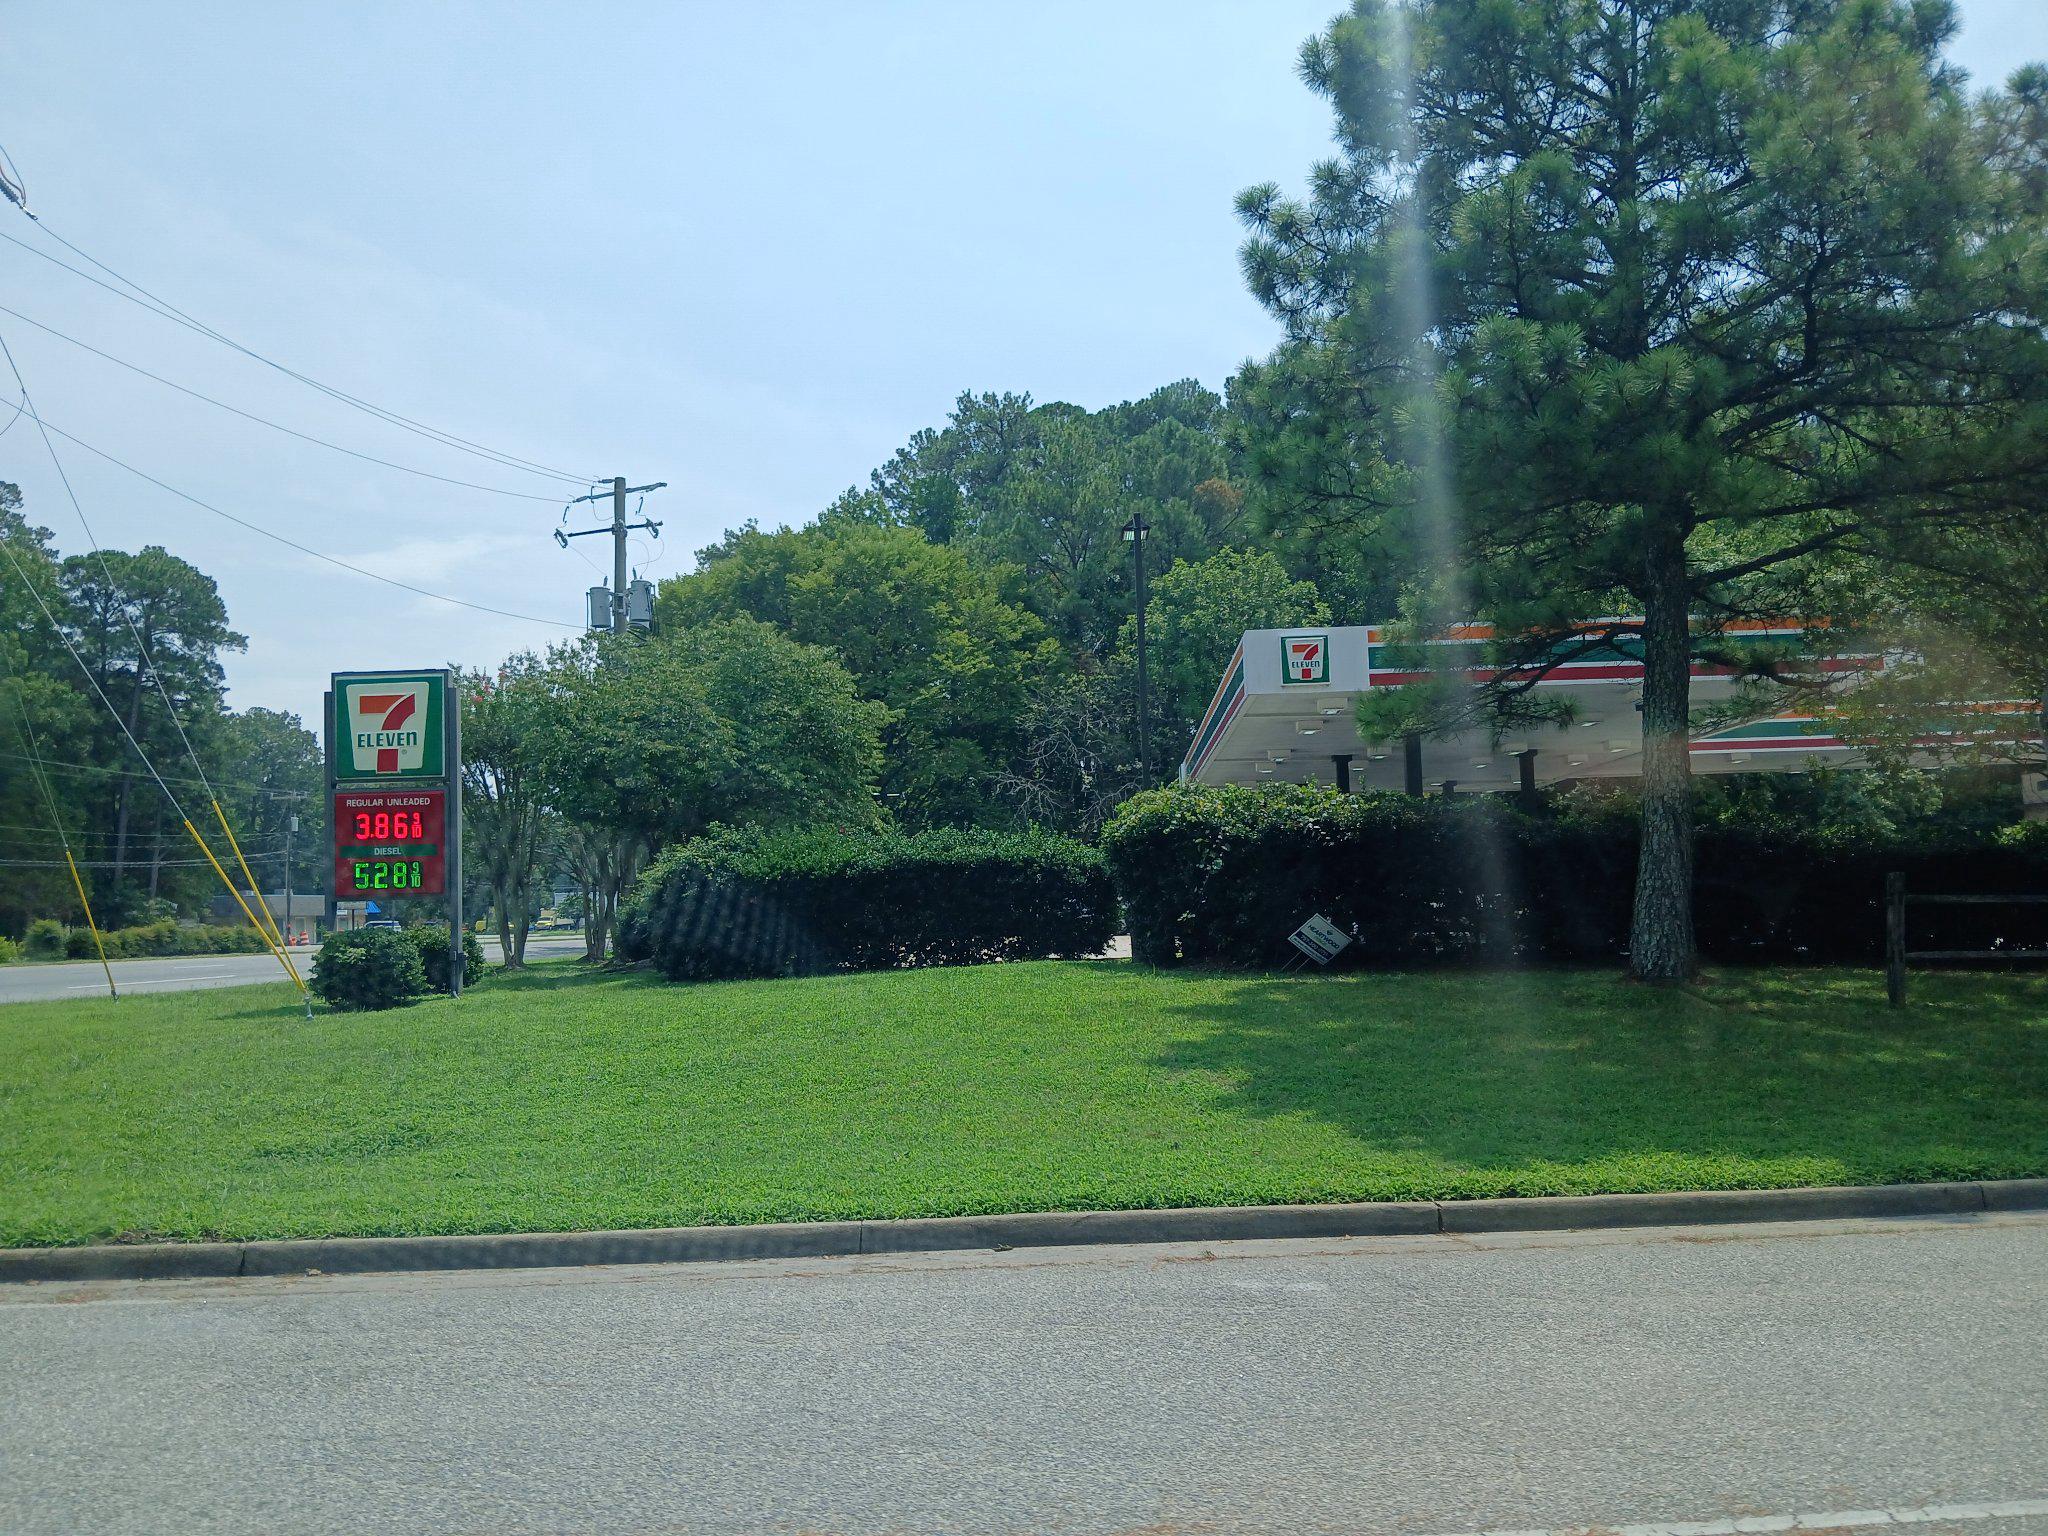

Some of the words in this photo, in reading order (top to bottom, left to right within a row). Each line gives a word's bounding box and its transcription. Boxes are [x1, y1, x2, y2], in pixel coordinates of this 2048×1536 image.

[346, 799, 384, 807] REGULAR
[387, 797, 431, 806] UNLEADED
[355, 812, 408, 840] 3.86
[374, 847, 402, 855] DIESEL
[355, 862, 407, 889] 5.28
